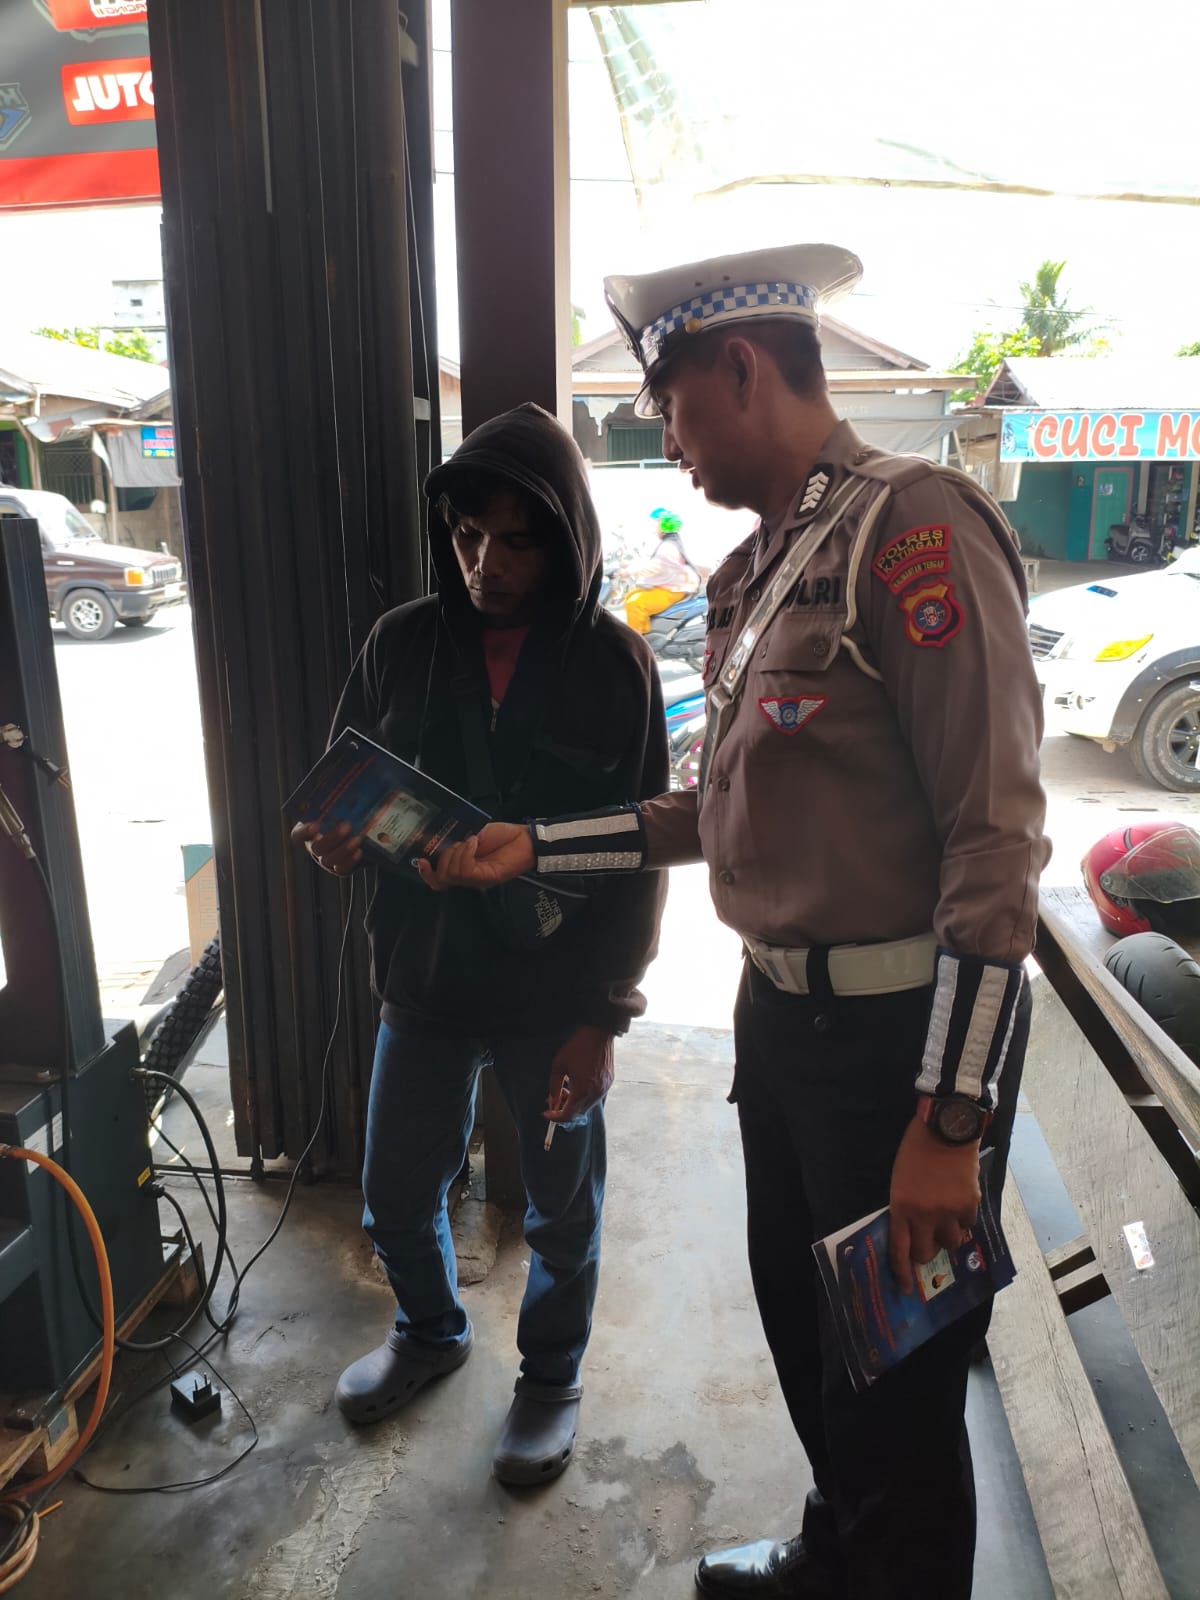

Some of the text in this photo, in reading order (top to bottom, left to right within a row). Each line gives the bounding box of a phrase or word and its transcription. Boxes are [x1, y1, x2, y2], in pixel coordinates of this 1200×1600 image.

[1034, 415, 1143, 457] CUCI
[877, 529, 943, 569] POLRES
[882, 540, 943, 574] KATINGAN
